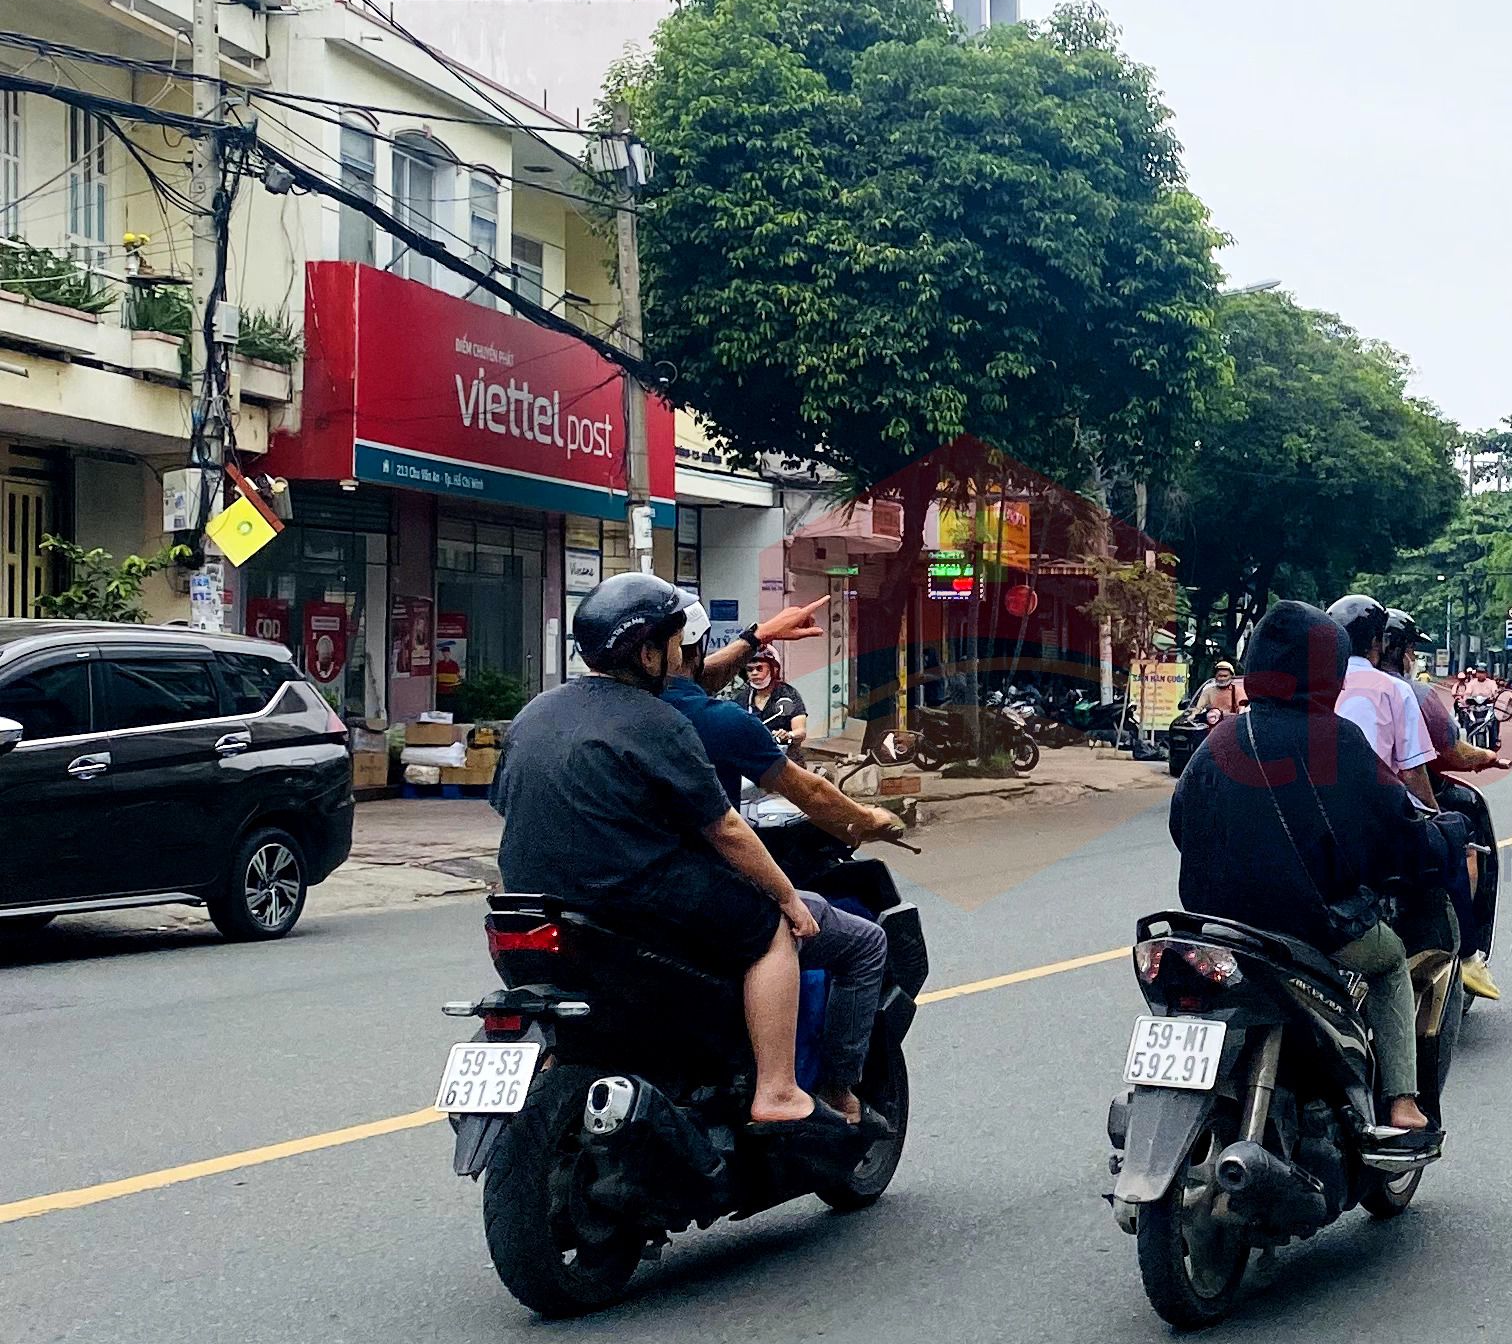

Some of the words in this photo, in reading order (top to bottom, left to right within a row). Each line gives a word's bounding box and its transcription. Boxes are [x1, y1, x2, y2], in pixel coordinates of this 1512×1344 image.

[455, 367, 563, 447] viettel
[567, 414, 613, 459] post
[458, 1049, 525, 1076] 59-S3
[1131, 1052, 1210, 1084] 592.91
[444, 1078, 519, 1108] 631.36
